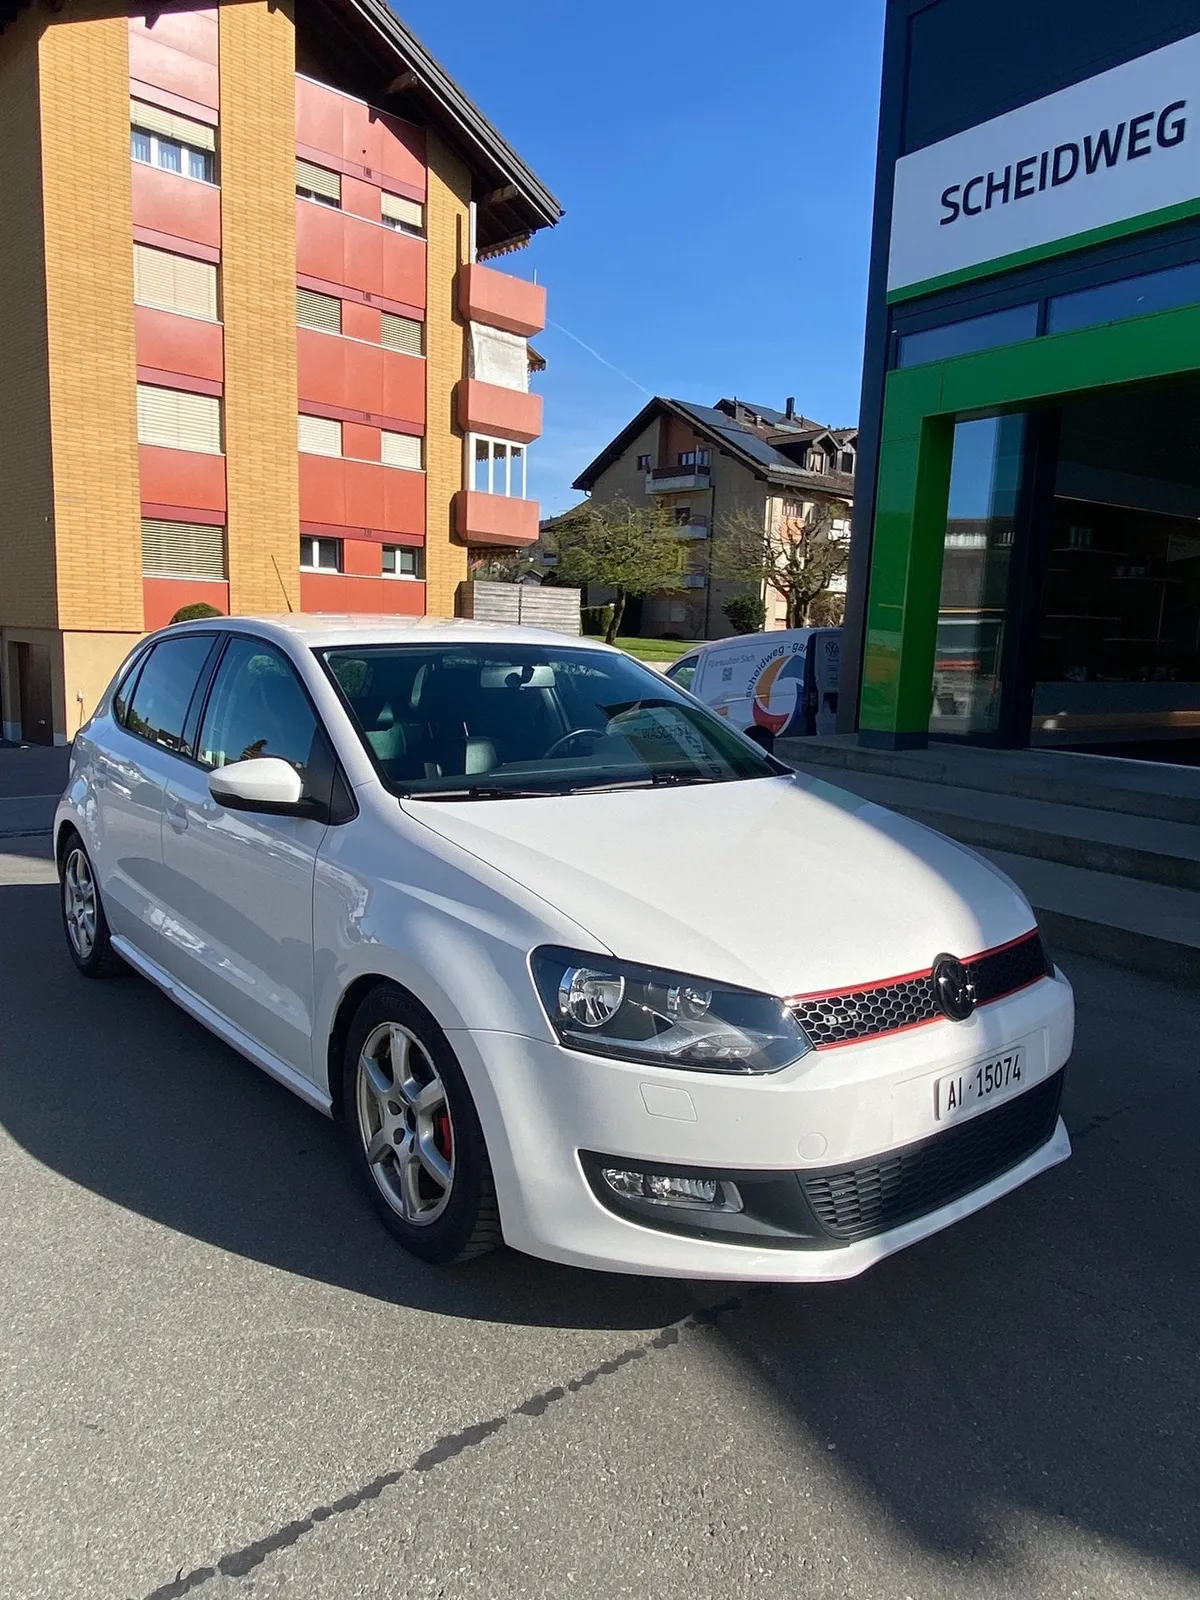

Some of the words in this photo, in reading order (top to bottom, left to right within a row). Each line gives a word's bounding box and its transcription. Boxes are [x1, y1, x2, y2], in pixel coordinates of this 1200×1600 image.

[940, 100, 1187, 226] SCHEIDWEG
[745, 645, 785, 698] scheidweg
[947, 1076, 963, 1111] AI
[976, 1054, 1021, 1098] 15074
